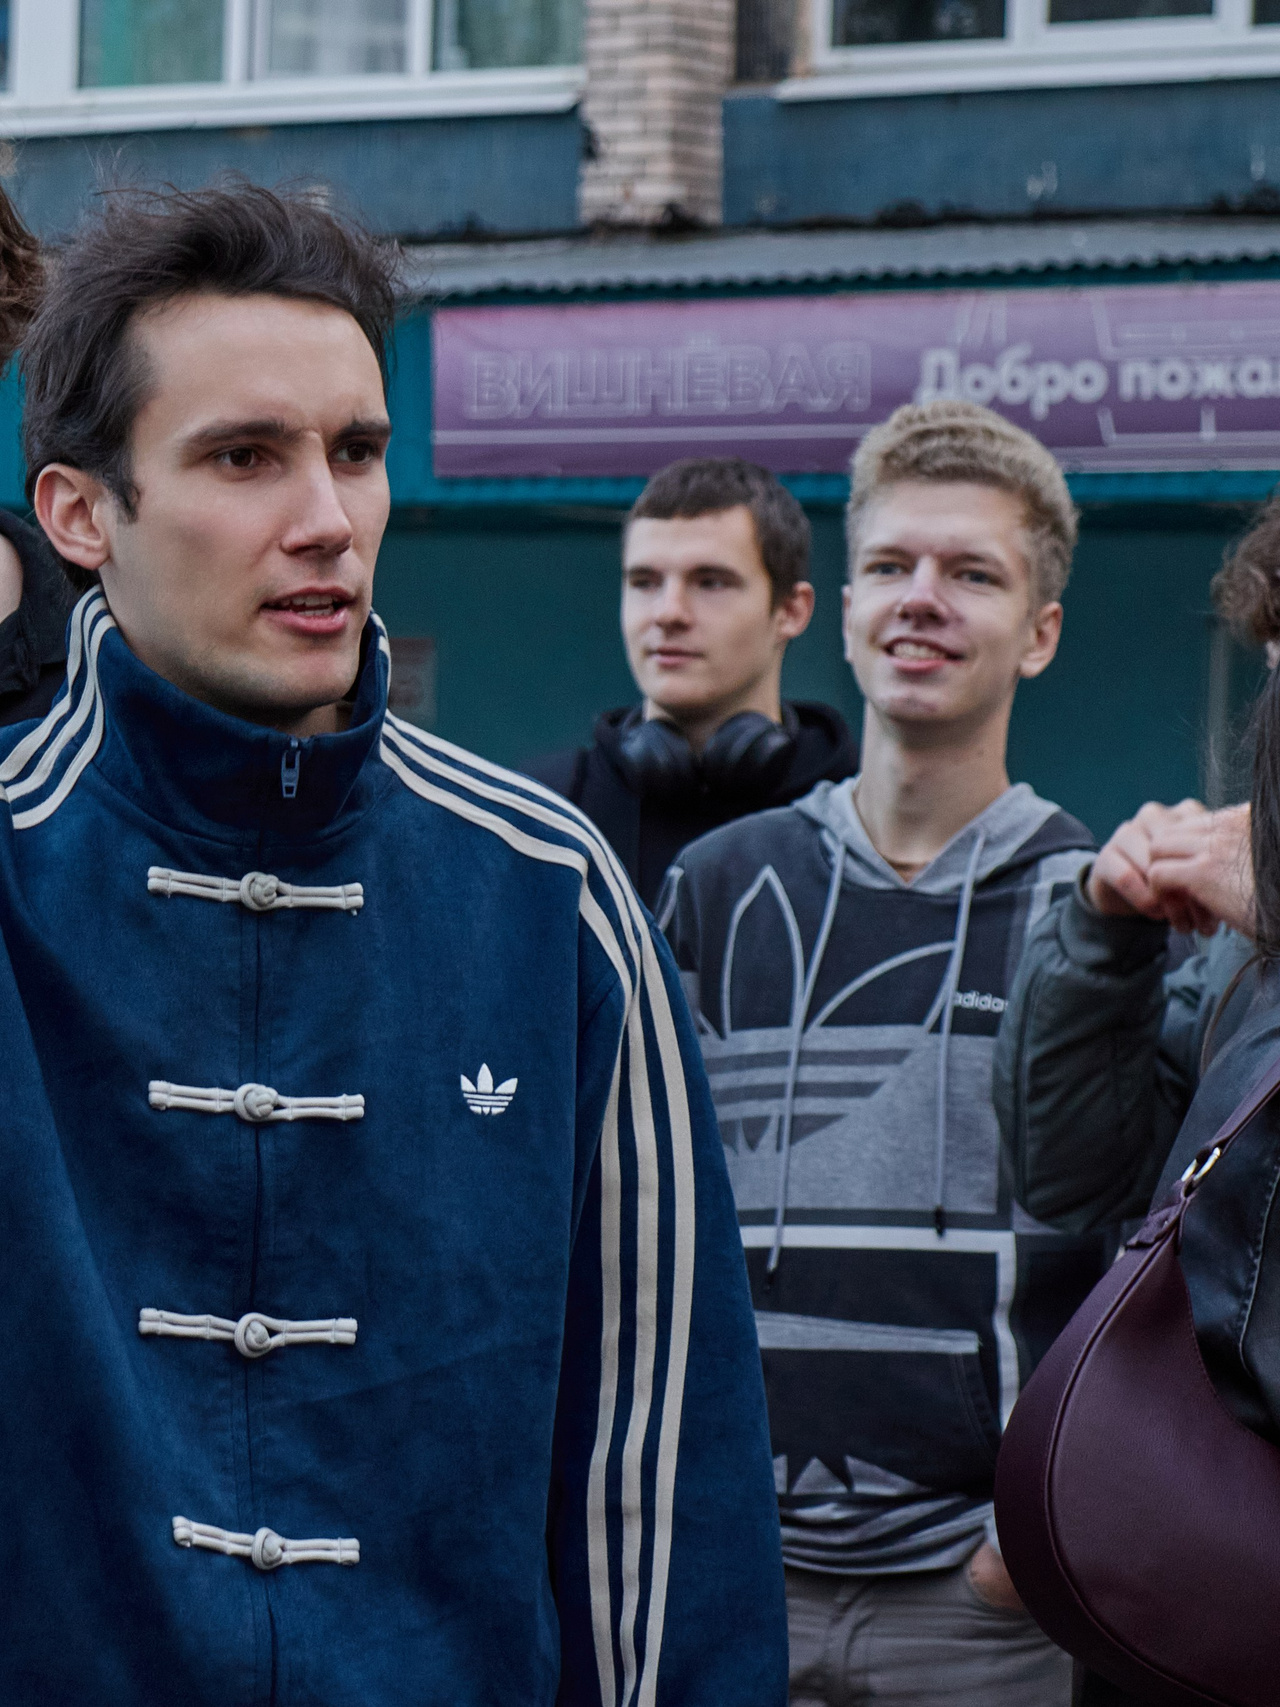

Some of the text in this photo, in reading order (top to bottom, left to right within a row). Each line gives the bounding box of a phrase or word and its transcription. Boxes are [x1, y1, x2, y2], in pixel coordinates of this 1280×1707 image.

[464, 332, 872, 420] ВИШНЁВАЯ
[914, 344, 1280, 420] Добро пожа
